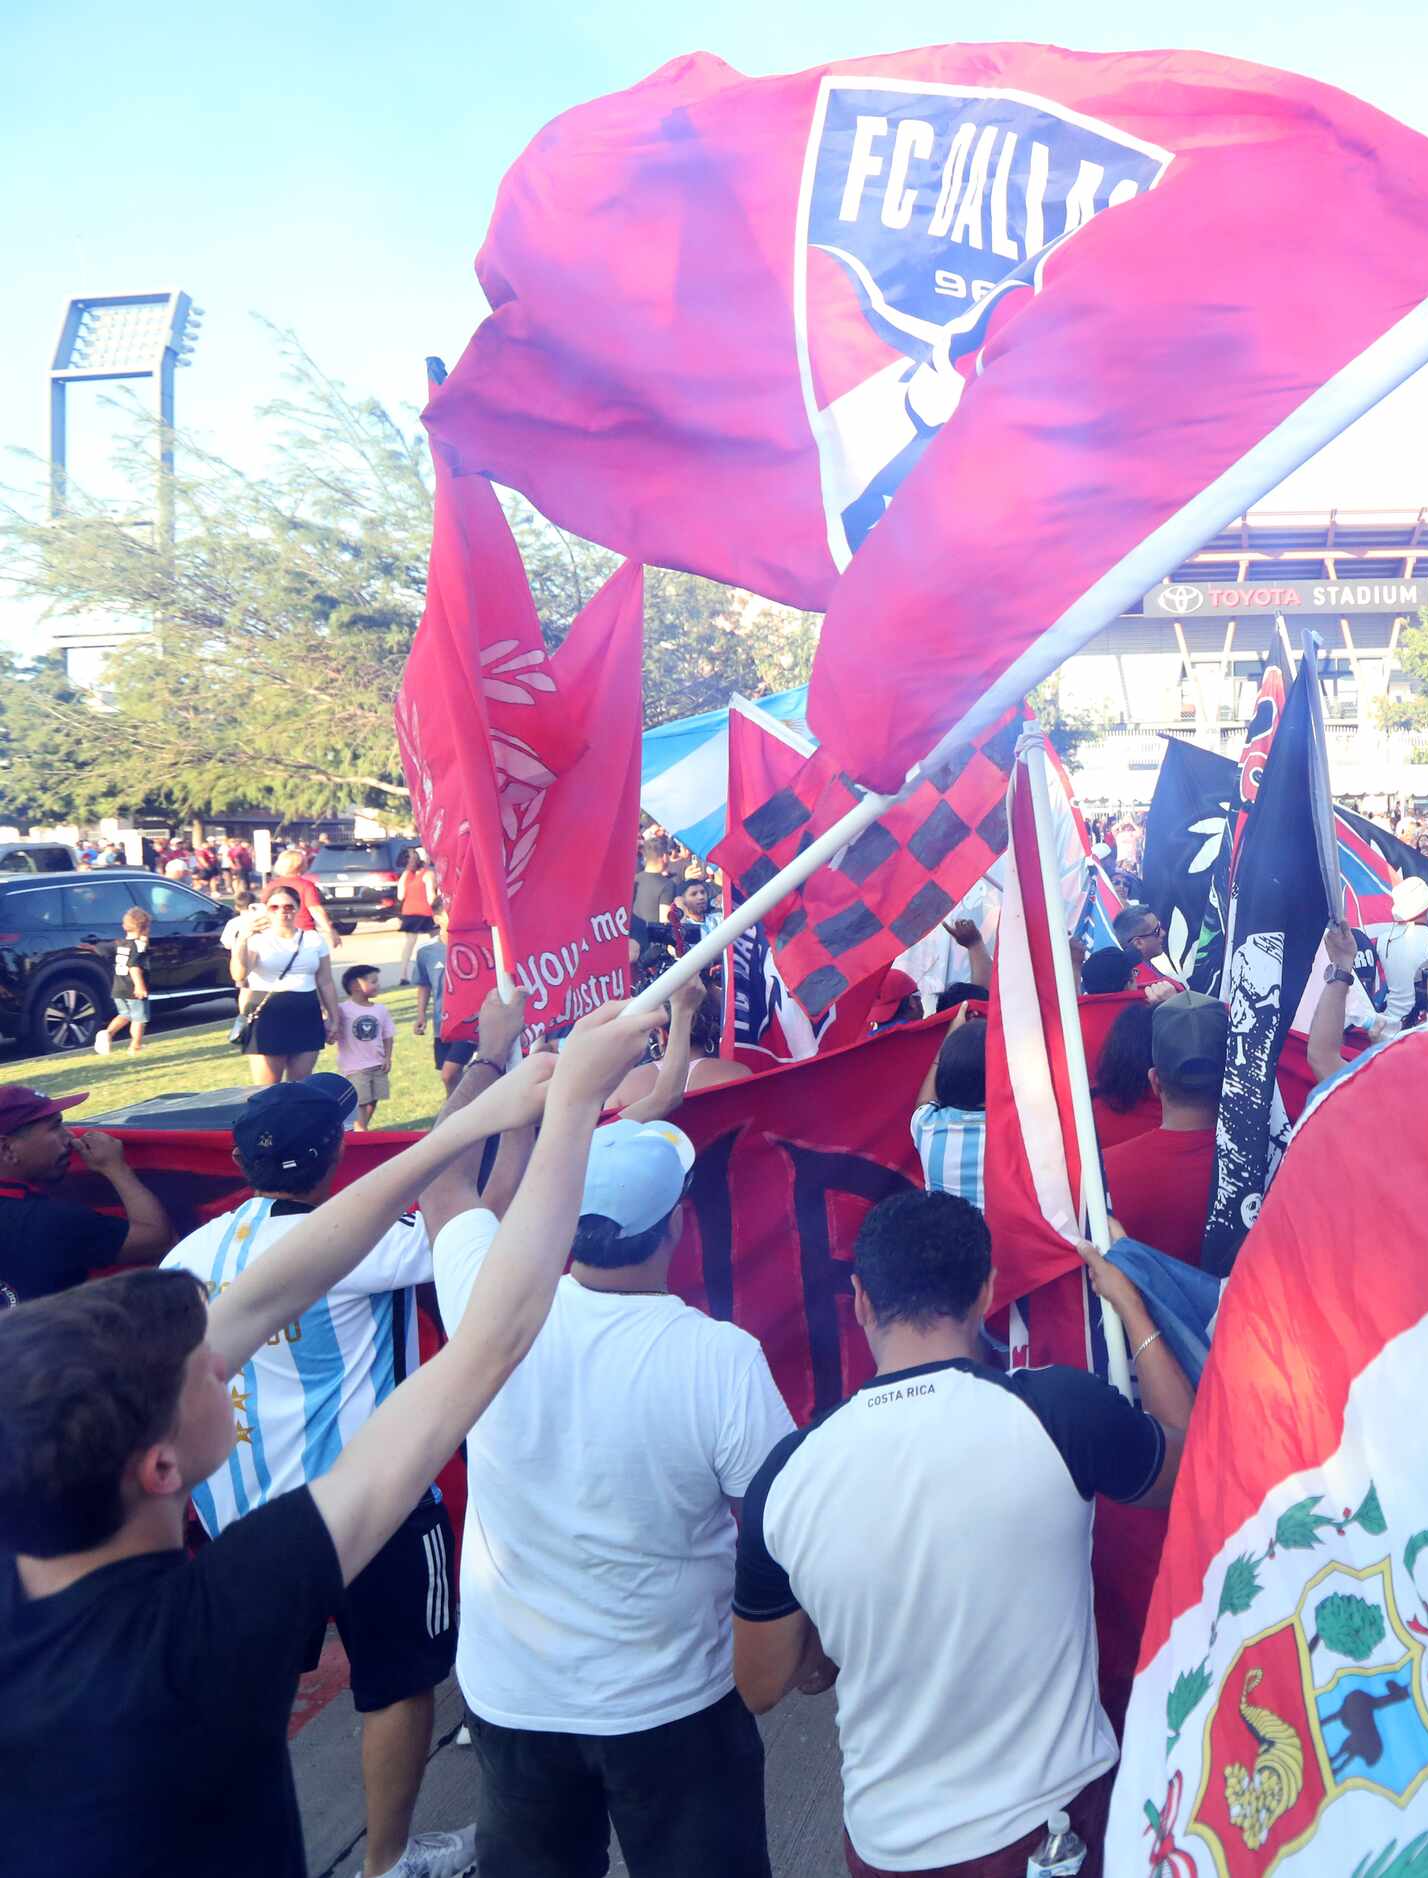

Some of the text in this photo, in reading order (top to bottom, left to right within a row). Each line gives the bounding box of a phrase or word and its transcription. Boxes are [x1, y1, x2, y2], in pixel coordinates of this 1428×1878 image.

[838, 115, 1138, 261] FC DALLA
[1206, 584, 1418, 608] TOYOTA STADIUM
[867, 1383, 936, 1408] COSTA RICA
